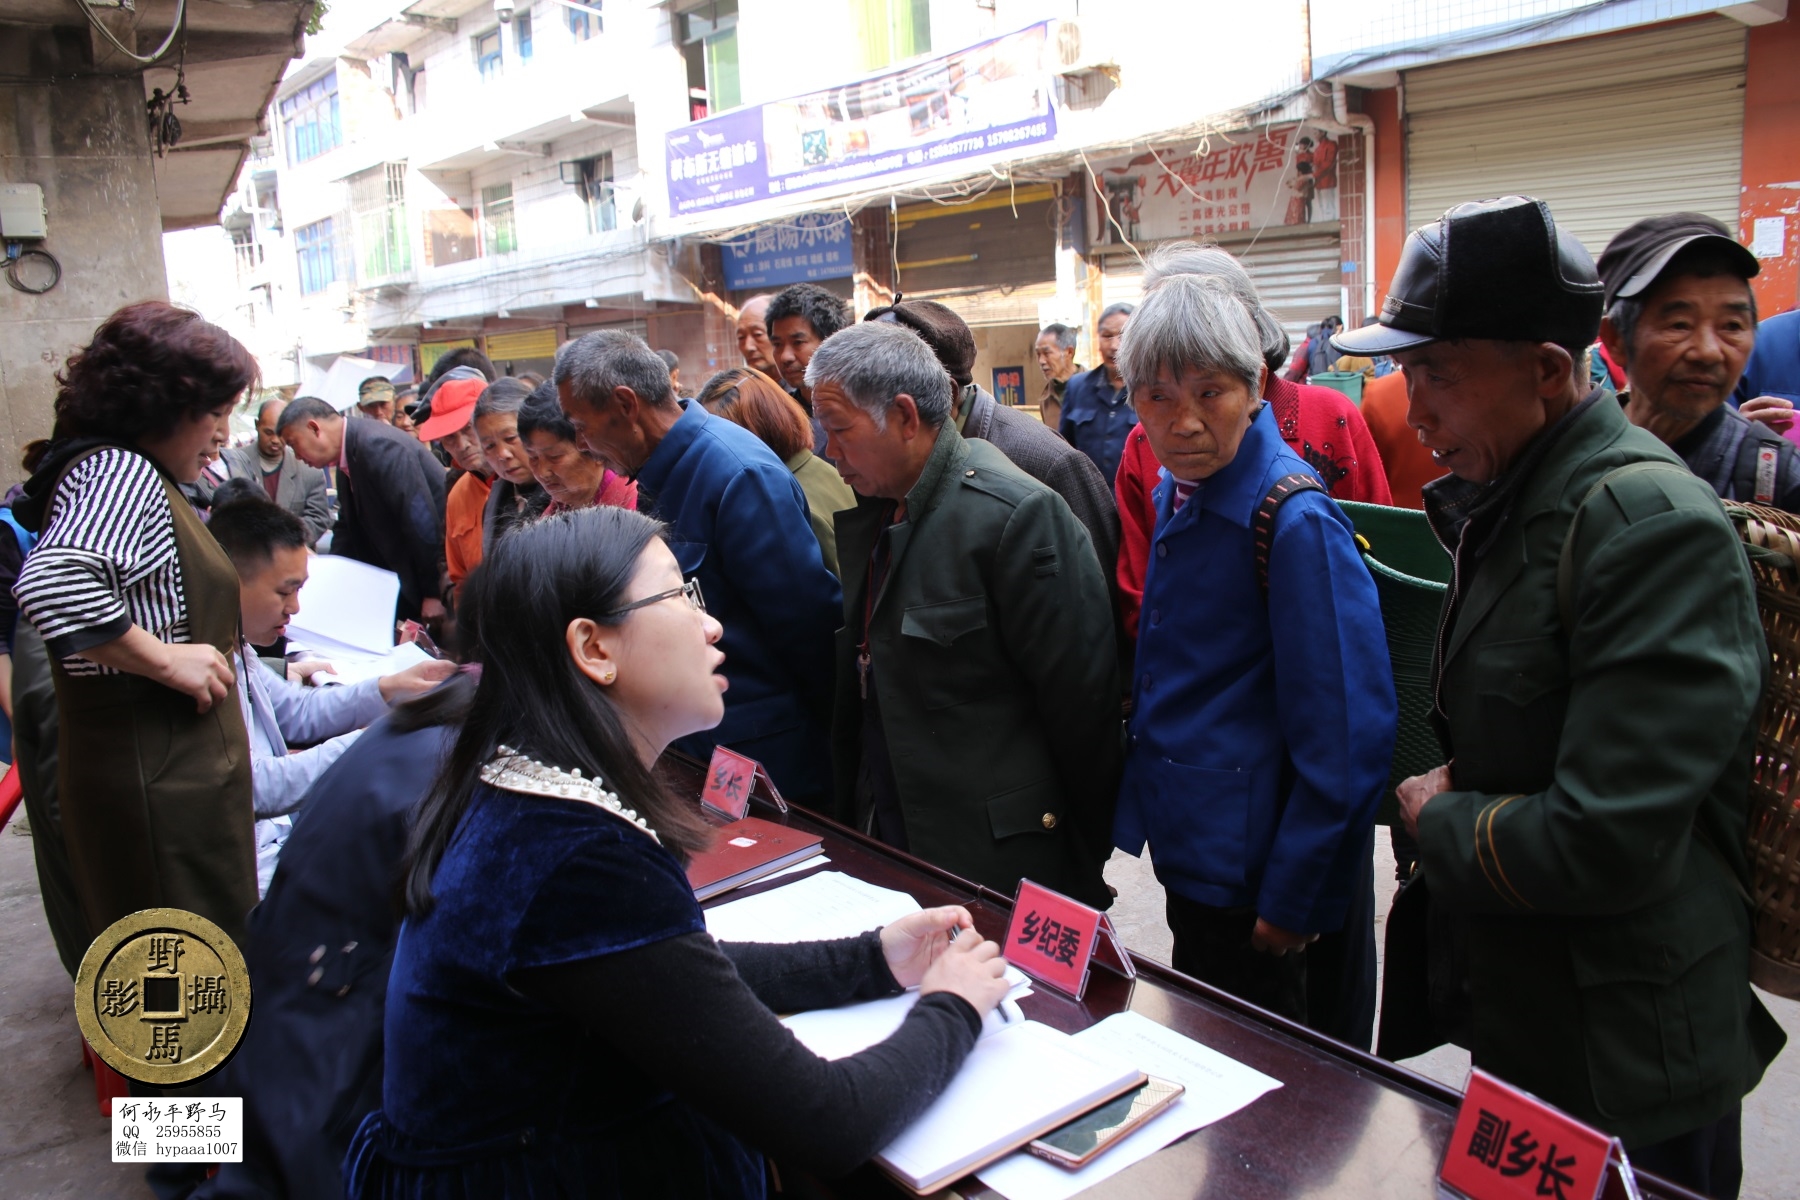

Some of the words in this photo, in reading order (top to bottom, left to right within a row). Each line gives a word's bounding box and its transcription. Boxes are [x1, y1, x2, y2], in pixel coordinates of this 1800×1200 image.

[1154, 126, 1296, 197] 天翼年欢惠
[711, 766, 743, 801] 乡长
[1017, 910, 1081, 968] 乡纪委
[1468, 1108, 1578, 1200] 副乡长
